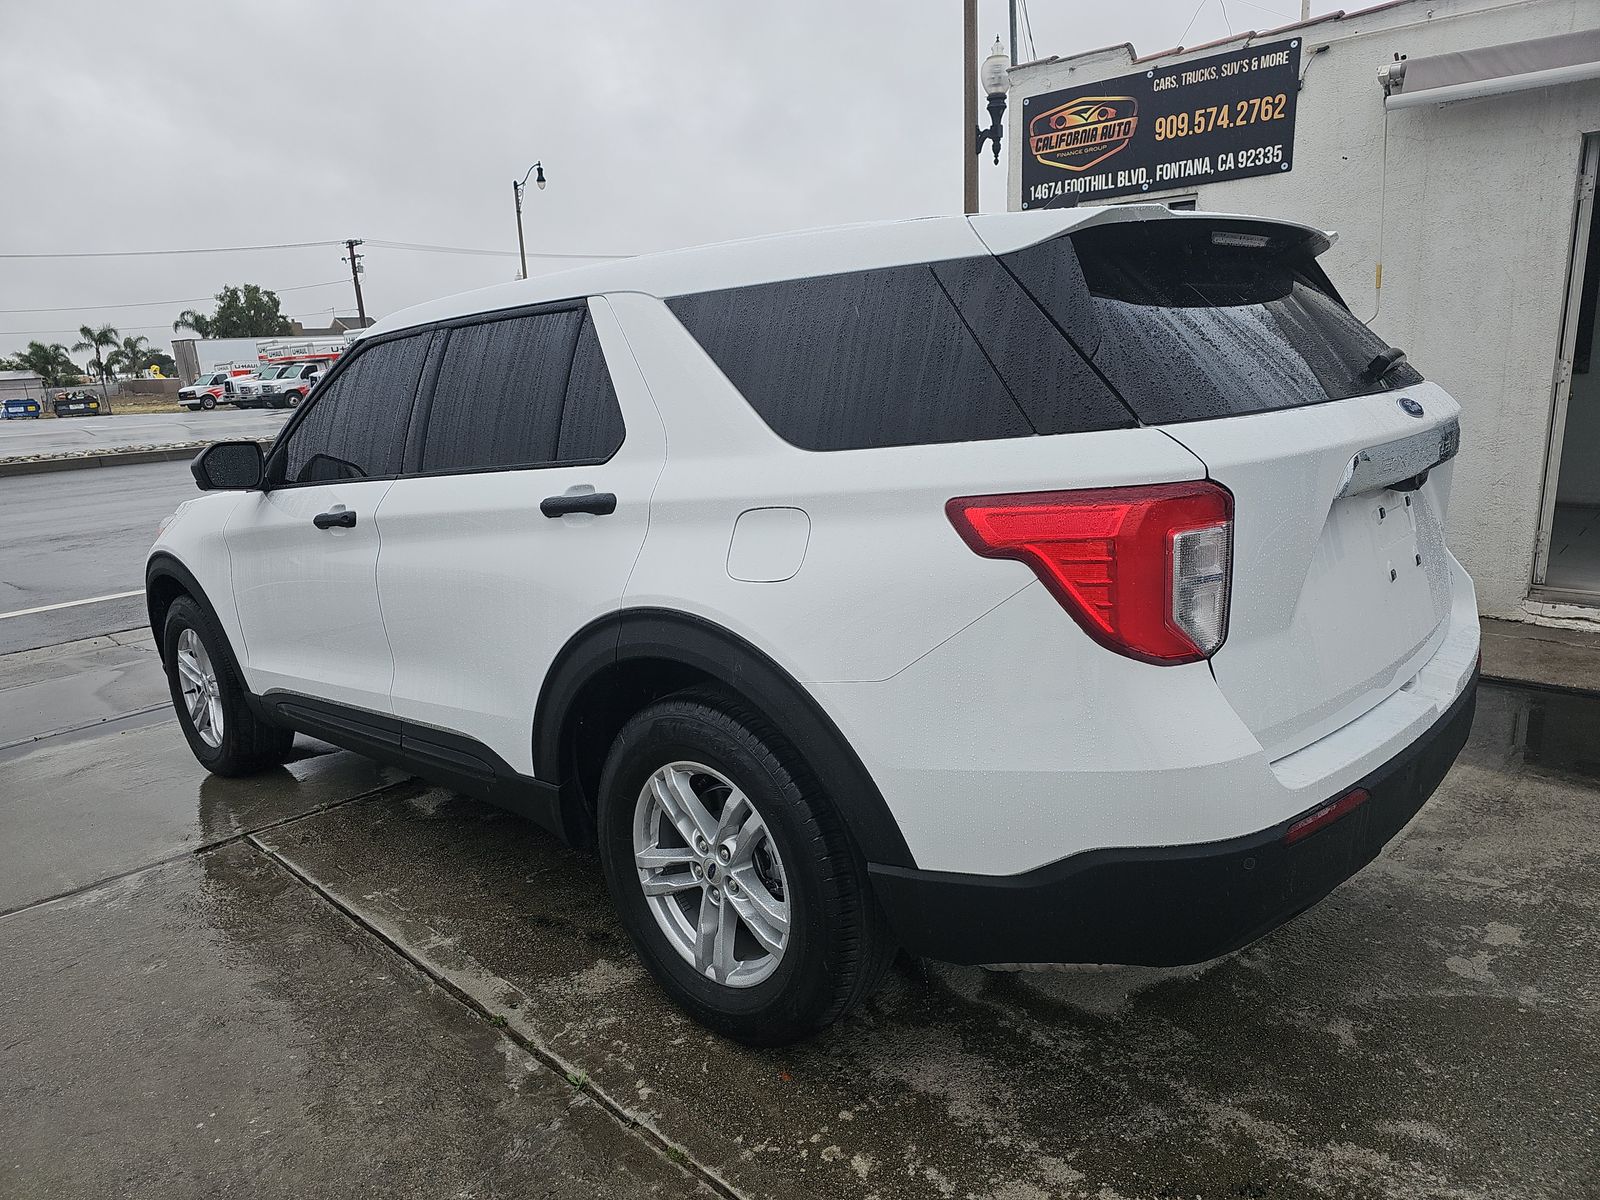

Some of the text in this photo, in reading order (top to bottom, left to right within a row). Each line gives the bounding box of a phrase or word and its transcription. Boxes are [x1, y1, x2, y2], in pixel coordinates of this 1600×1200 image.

[1153, 50, 1290, 92] CARS, TRUCKS, SUV'S & MORE
[1035, 120, 1132, 153] CALIFORNIA AUTO
[1155, 93, 1287, 141] 909.574.2762
[1056, 144, 1108, 158] FINANCE GROUP
[1030, 144, 1283, 201] 14674 FOOTHILL BLVD., FONTANA, CA 92335
